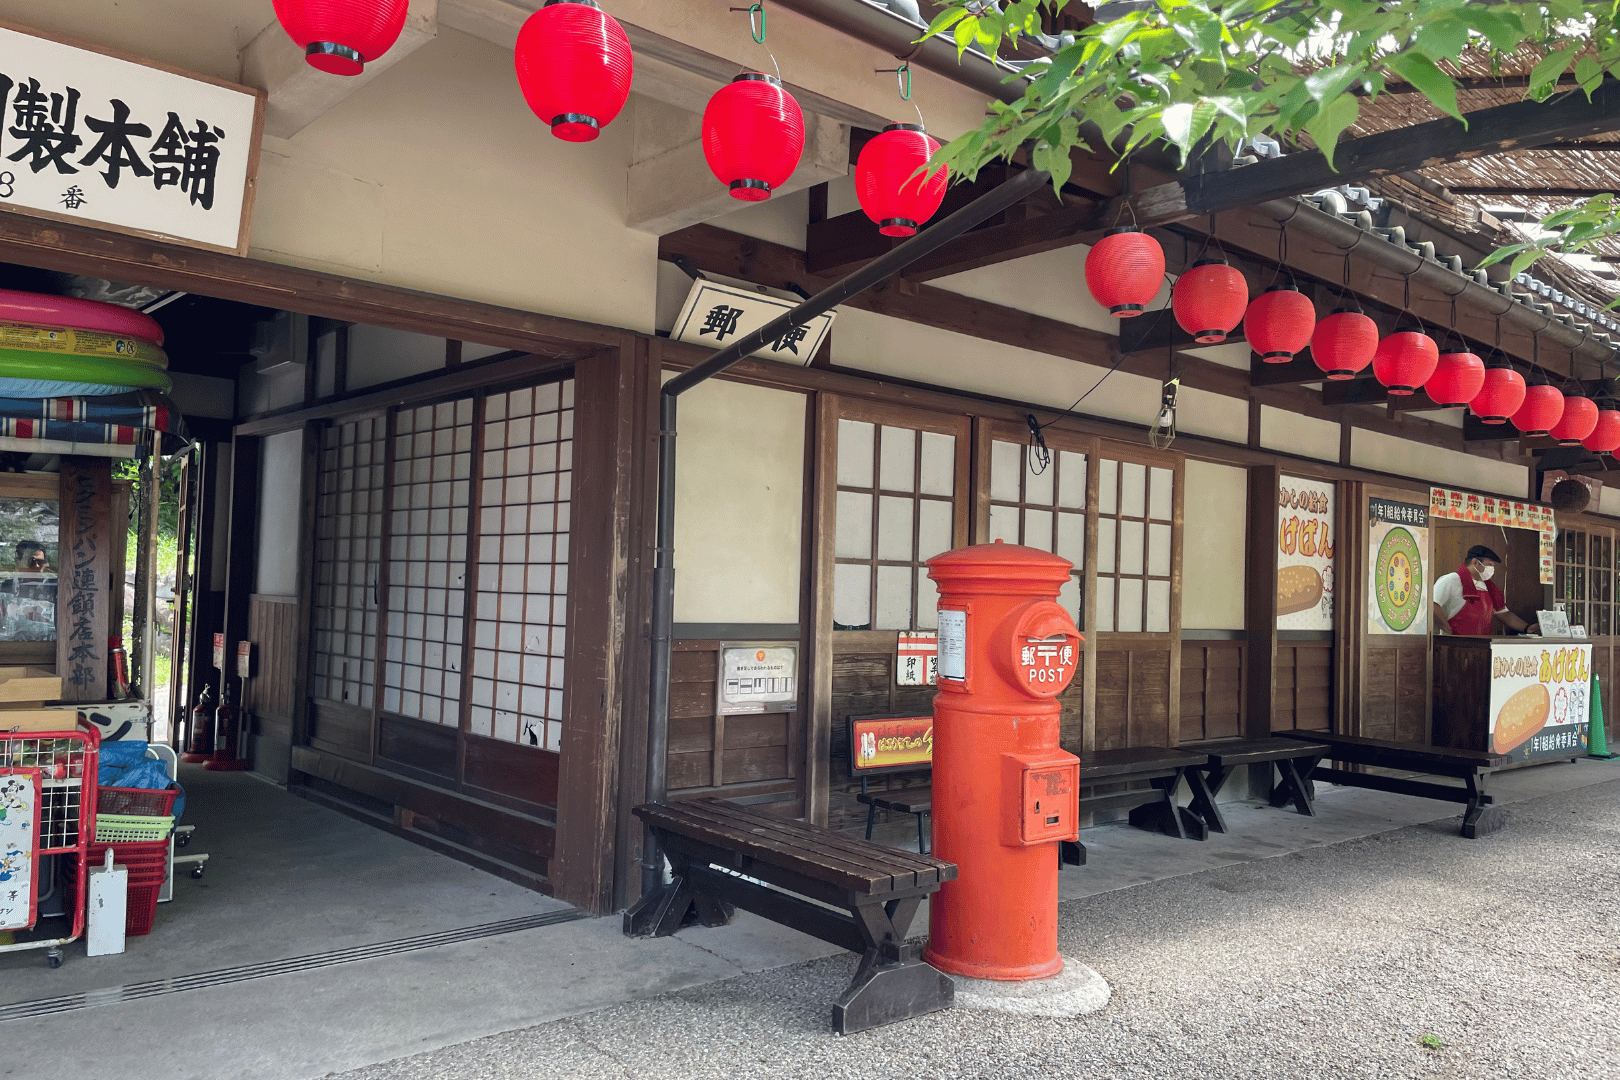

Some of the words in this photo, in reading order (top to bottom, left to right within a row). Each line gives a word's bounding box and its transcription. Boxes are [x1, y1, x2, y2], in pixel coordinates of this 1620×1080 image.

[0, 73, 225, 210] 製本舗
[59, 185, 88, 210] 番
[1375, 503, 1425, 523] 1年1組給食委員会
[905, 656, 917, 682] 印紙
[1029, 667, 1065, 683] POST
[1539, 647, 1590, 683] あげぱん
[1530, 731, 1578, 752] 1年1組給食委員会
